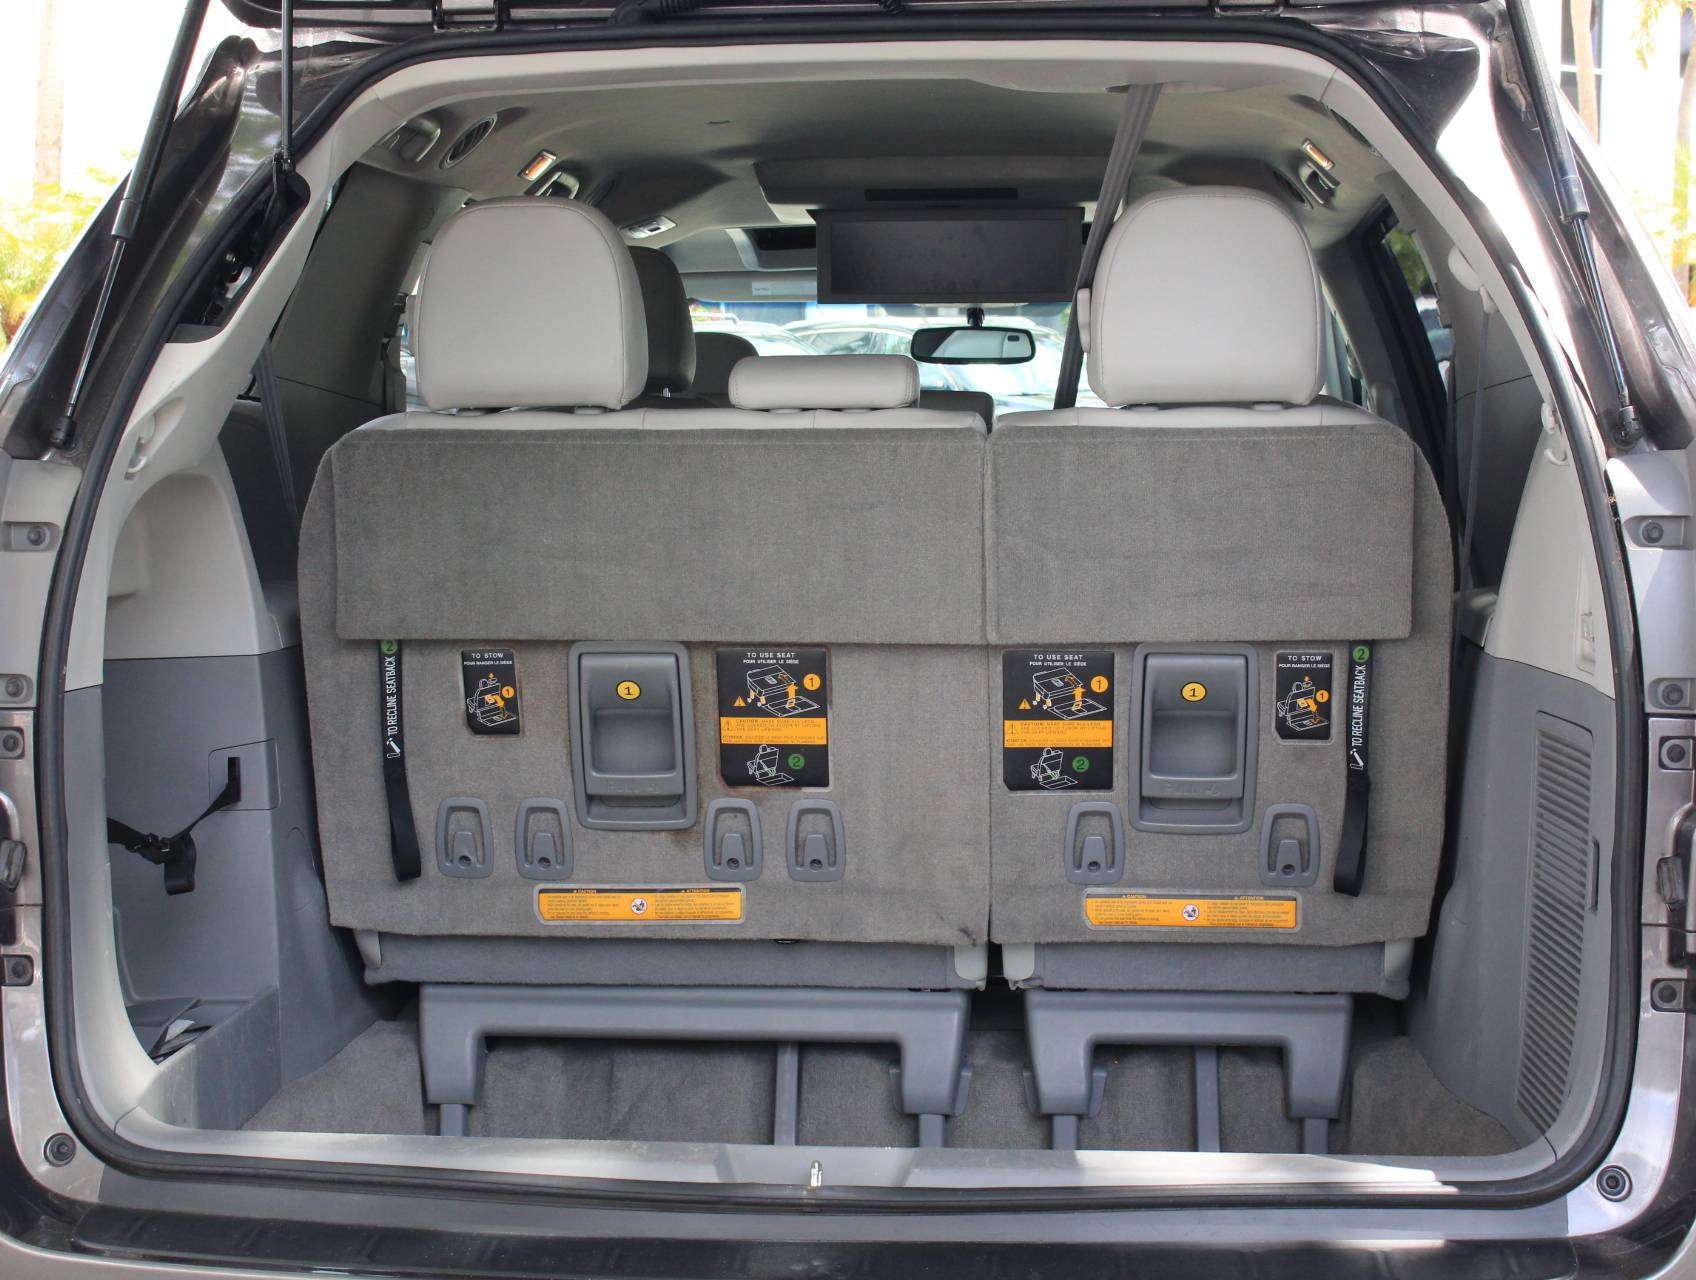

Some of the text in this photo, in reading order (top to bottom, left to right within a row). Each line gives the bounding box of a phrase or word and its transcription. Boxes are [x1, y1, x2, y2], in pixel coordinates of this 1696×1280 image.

[384, 655, 398, 736] TO RECLINE SEATBACK
[1351, 664, 1367, 747] TO RECLINE SEATBACK
